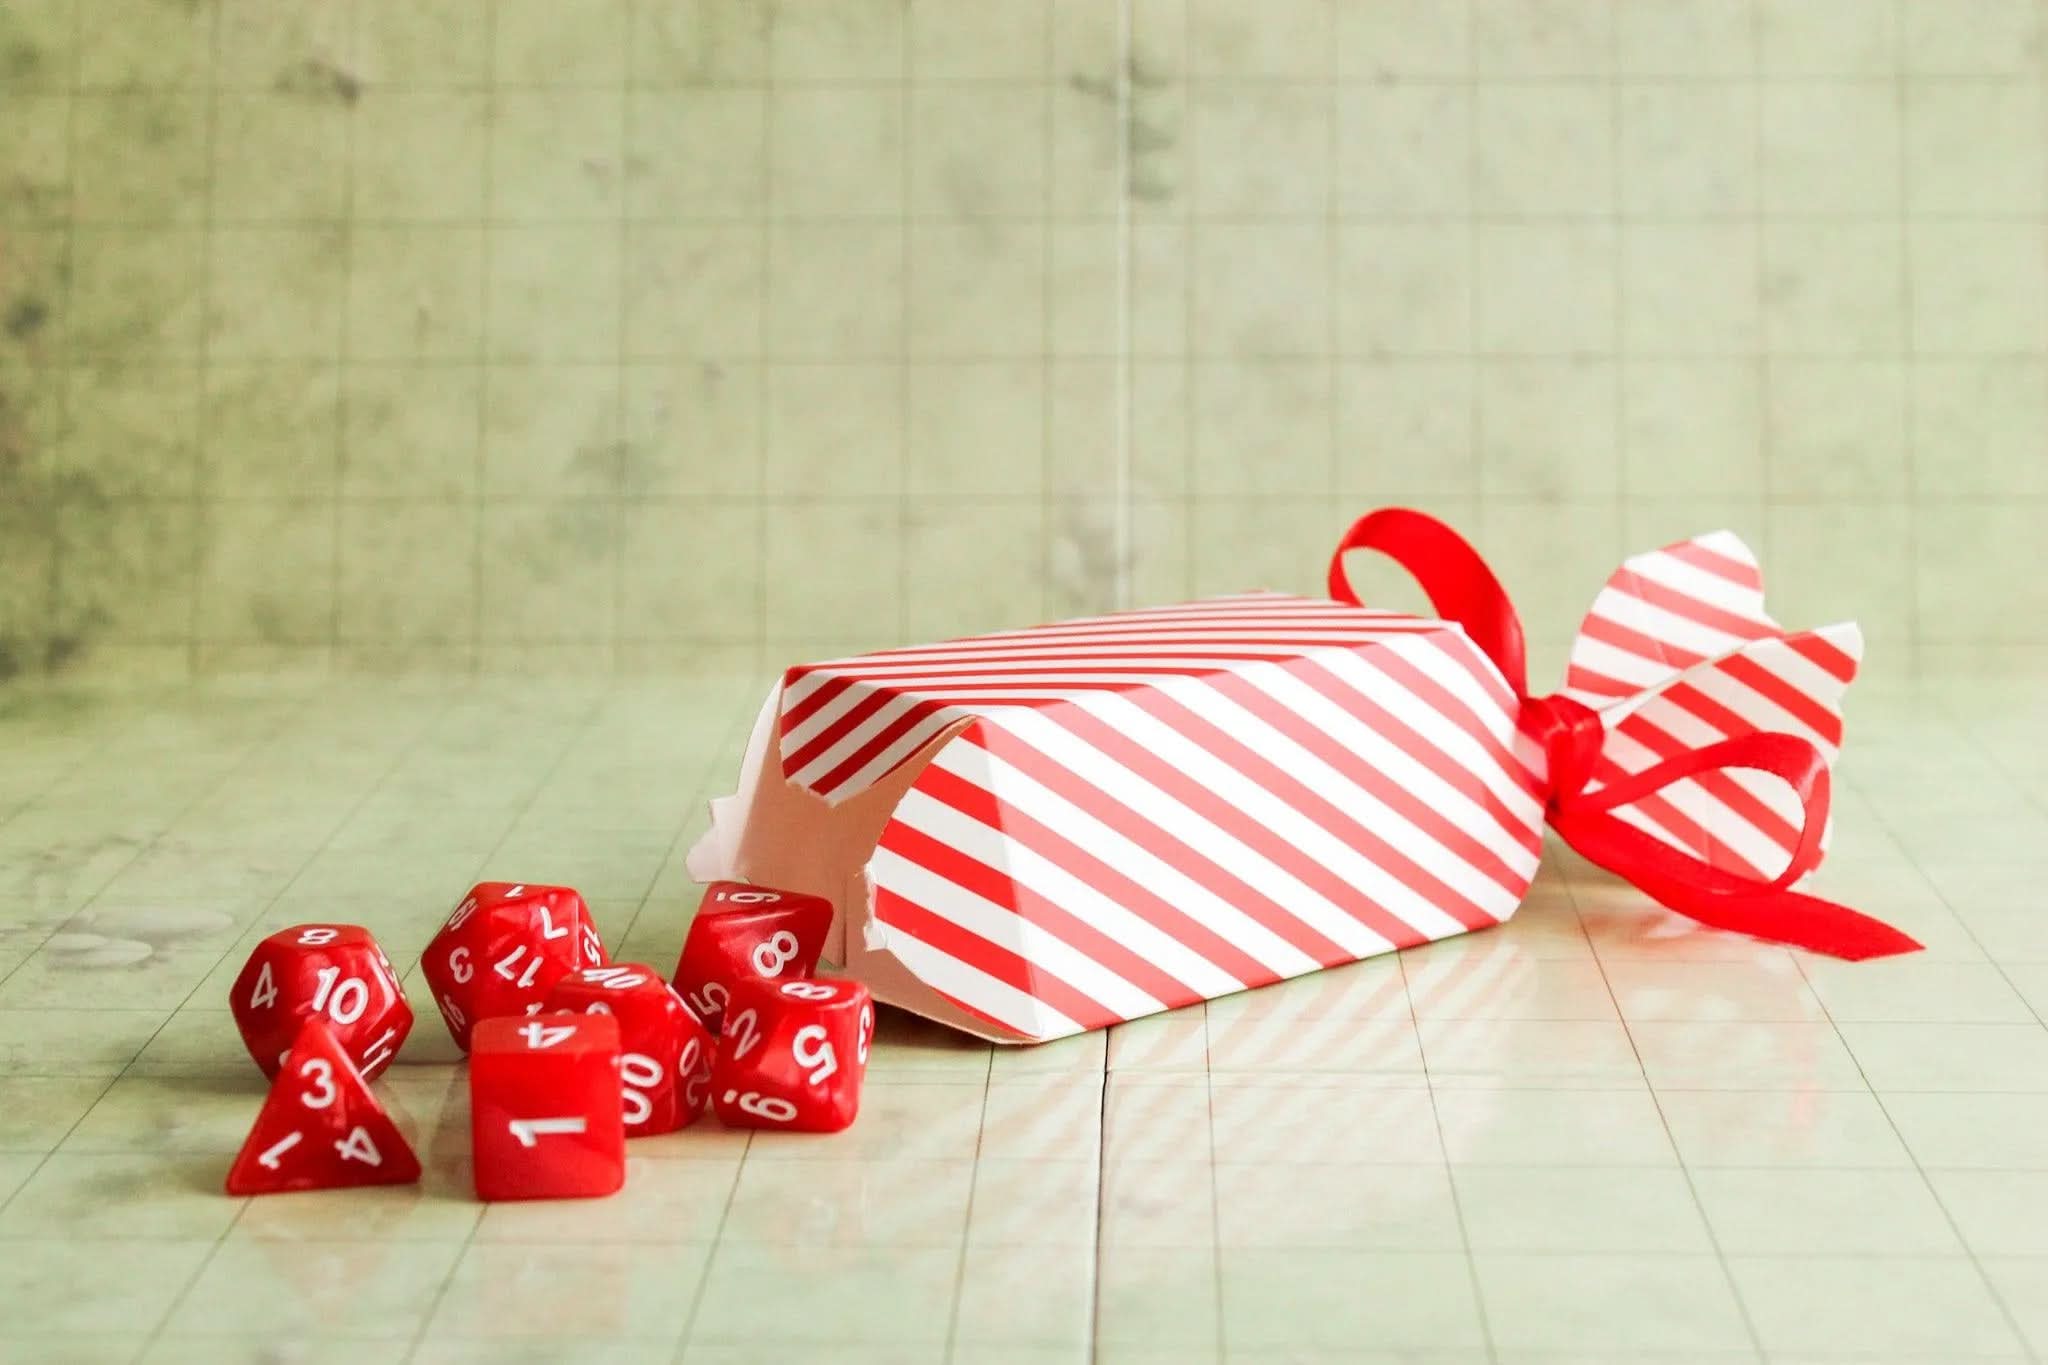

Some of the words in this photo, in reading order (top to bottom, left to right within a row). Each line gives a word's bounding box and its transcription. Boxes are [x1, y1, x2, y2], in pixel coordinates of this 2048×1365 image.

[297, 929, 339, 945] 8
[540, 906, 569, 940] 7
[449, 946, 474, 984] 3
[494, 945, 543, 988] 17
[752, 930, 799, 978] 8
[251, 961, 278, 1009] 4
[312, 966, 369, 1025] 10
[781, 981, 838, 1000] 8
[519, 1022, 577, 1049] 4
[730, 1008, 761, 1061] 2
[792, 1024, 838, 1086] 5
[300, 1058, 336, 1109] 3
[259, 1131, 303, 1170] 1
[334, 1126, 383, 1167] 4
[509, 1117, 587, 1147] 1
